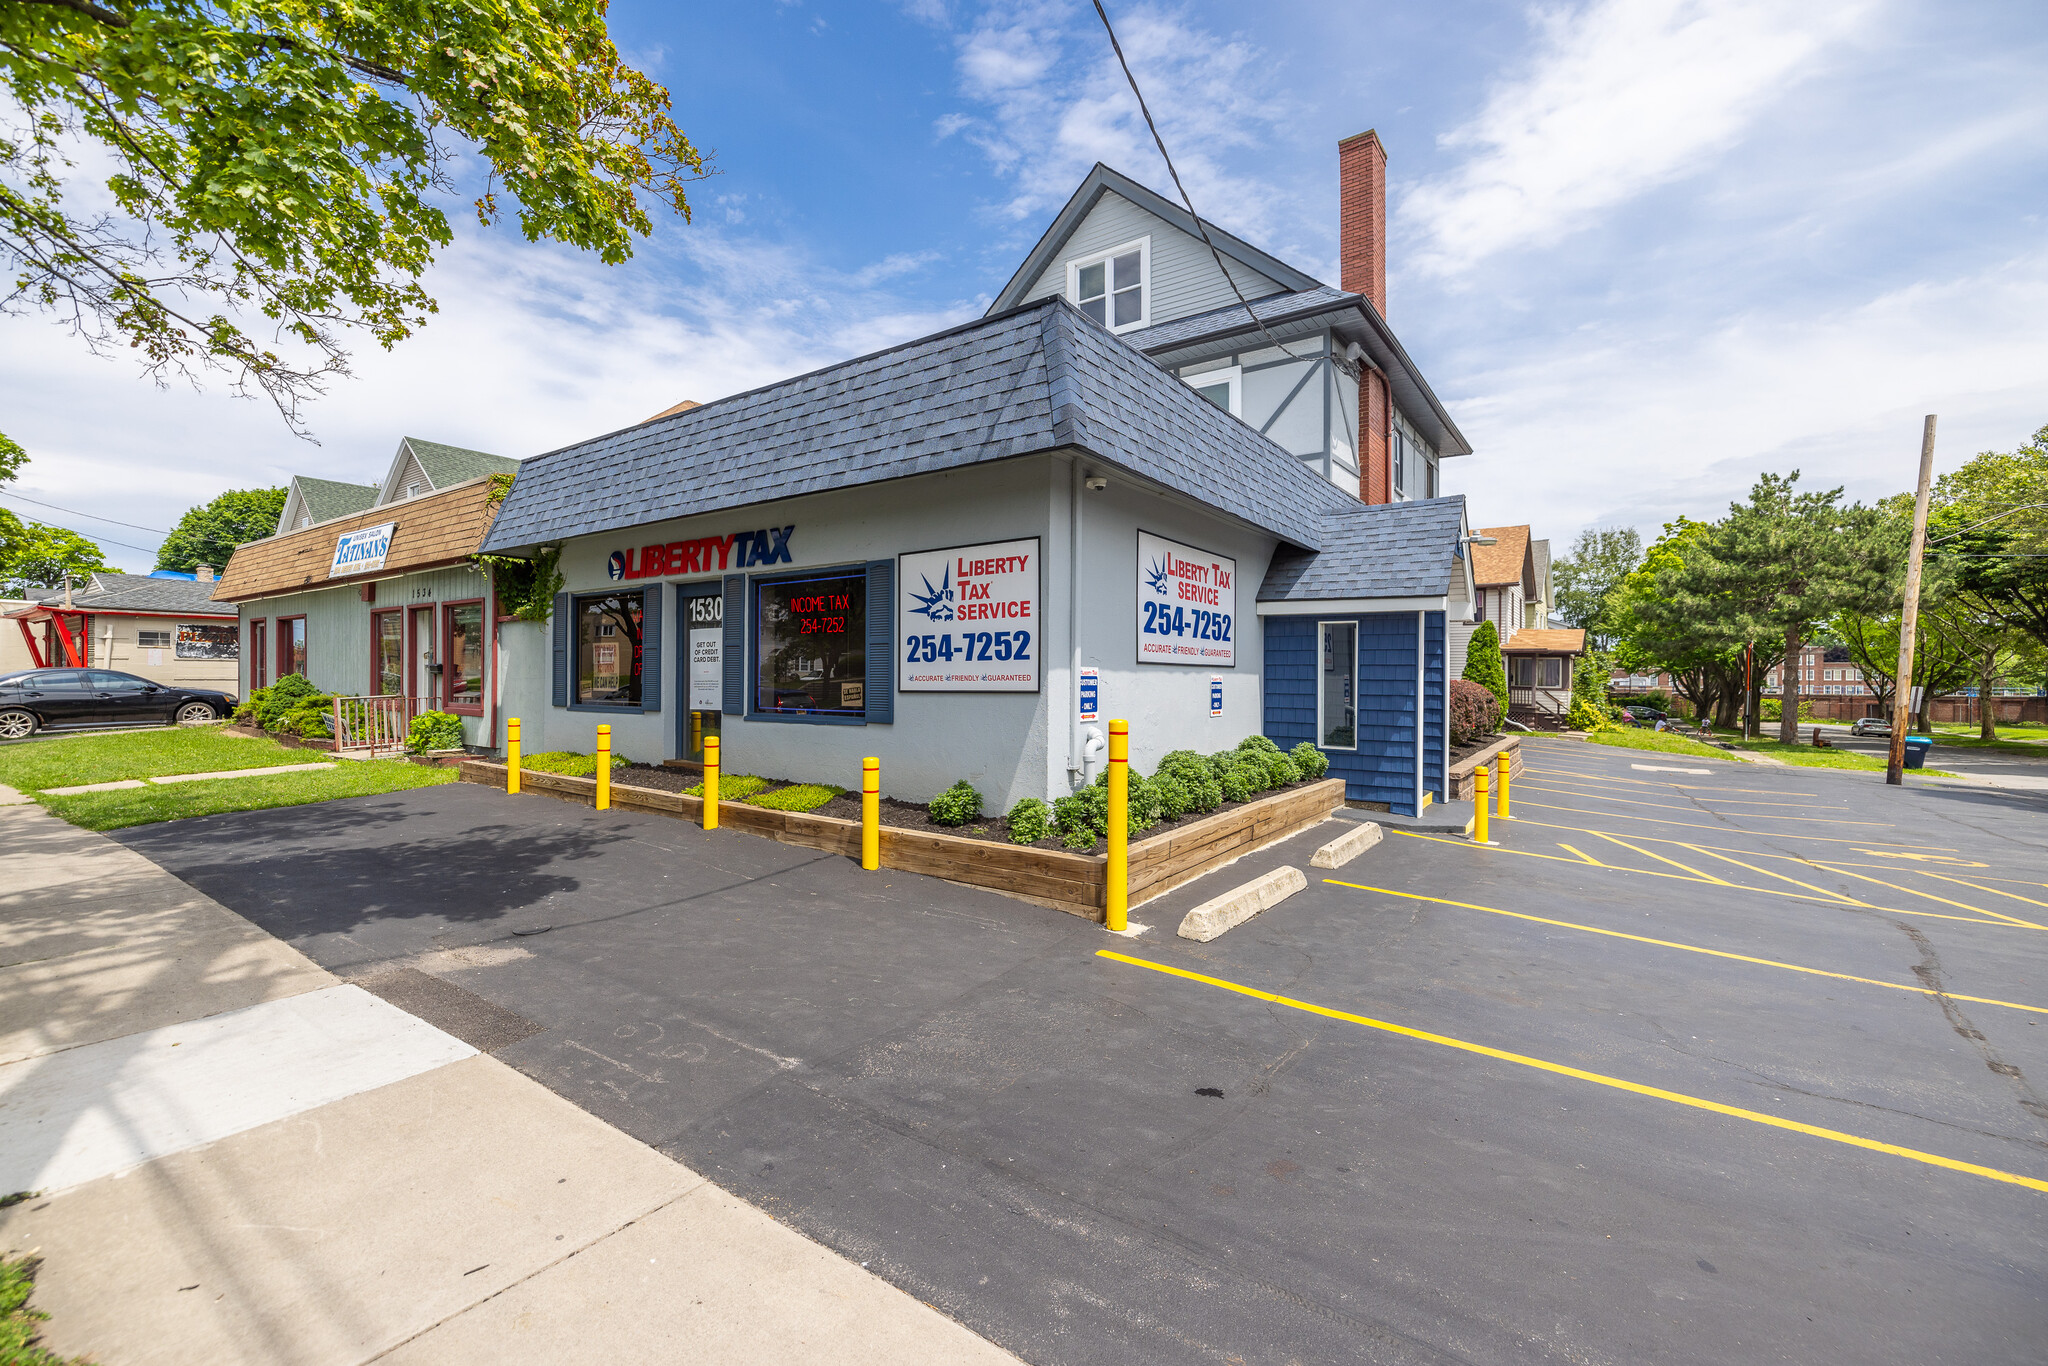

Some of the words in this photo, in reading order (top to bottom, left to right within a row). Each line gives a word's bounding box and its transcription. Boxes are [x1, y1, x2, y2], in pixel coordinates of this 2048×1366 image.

[336, 535, 388, 565] TATINAN'S
[957, 555, 1029, 577] LIBERTY
[1167, 552, 1209, 584] LIBERTY
[1212, 563, 1231, 589] TAX
[412, 587, 431, 599] 1534
[957, 580, 990, 600] TAX
[1178, 581, 1219, 606] SERVICE
[690, 597, 723, 621] 1530
[791, 596, 826, 613] INCOME
[828, 594, 850, 610] TAX
[957, 601, 1031, 621] SERVICE
[800, 617, 845, 634] 254-7252
[1143, 601, 1231, 642] 254-7252
[907, 630, 1031, 662] 254-7252
[1143, 643, 1172, 653] ACCURATE
[1177, 646, 1200, 656] FRIENDLY
[1204, 648, 1231, 658] GUARANTEED
[987, 674, 1032, 682] GUARANTEED
